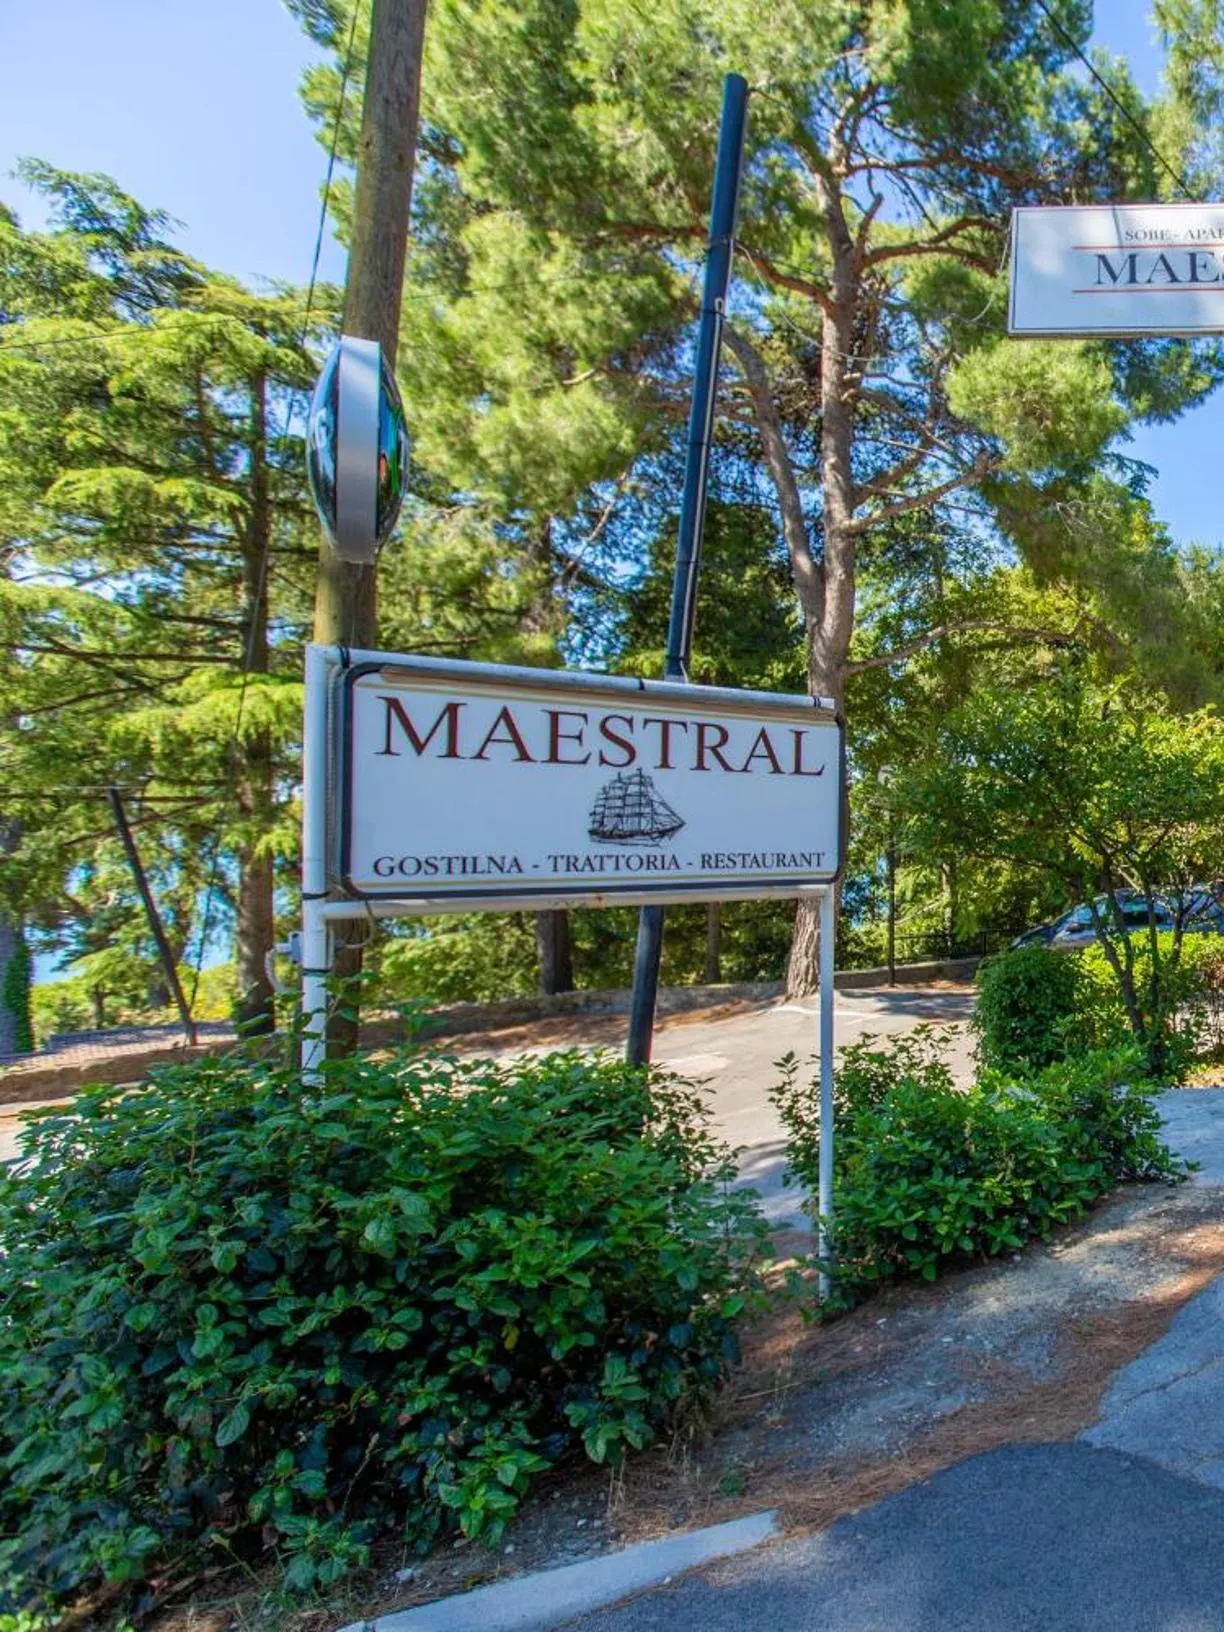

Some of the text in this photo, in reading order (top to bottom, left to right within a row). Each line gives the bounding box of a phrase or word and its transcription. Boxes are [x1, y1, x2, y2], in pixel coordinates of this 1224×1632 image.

[374, 696, 826, 777] MAESTRAL
[372, 854, 524, 877] GOSTILNA
[547, 852, 681, 873] TRATTORIA
[700, 851, 826, 870] RESTAURANT
